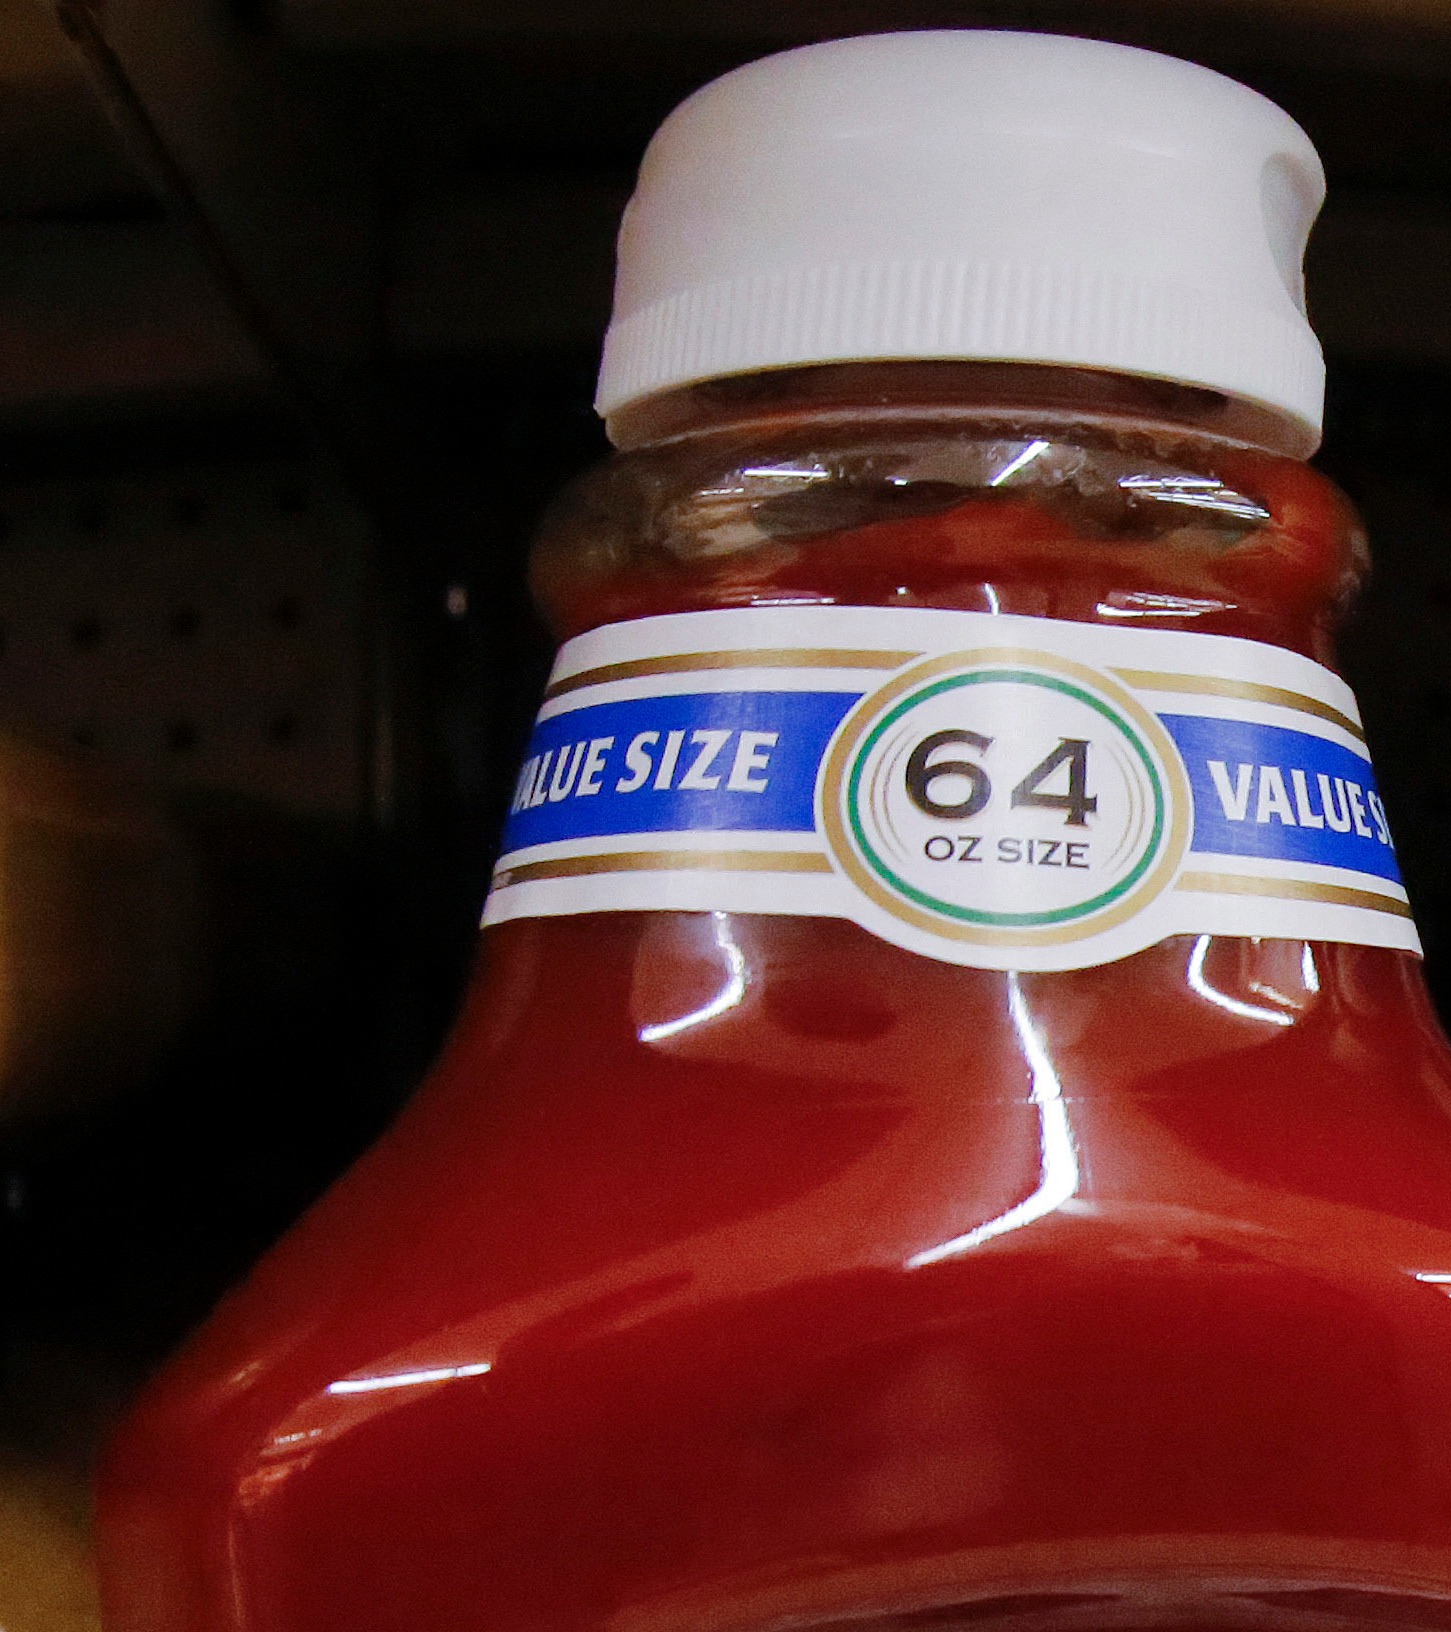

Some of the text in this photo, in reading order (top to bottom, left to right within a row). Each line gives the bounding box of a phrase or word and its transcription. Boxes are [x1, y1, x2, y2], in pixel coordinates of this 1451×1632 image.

[615, 729, 780, 794] SIZE
[904, 728, 1099, 829] 64
[1206, 759, 1373, 839] VALUE
[923, 835, 1092, 871] OZ SIZE
